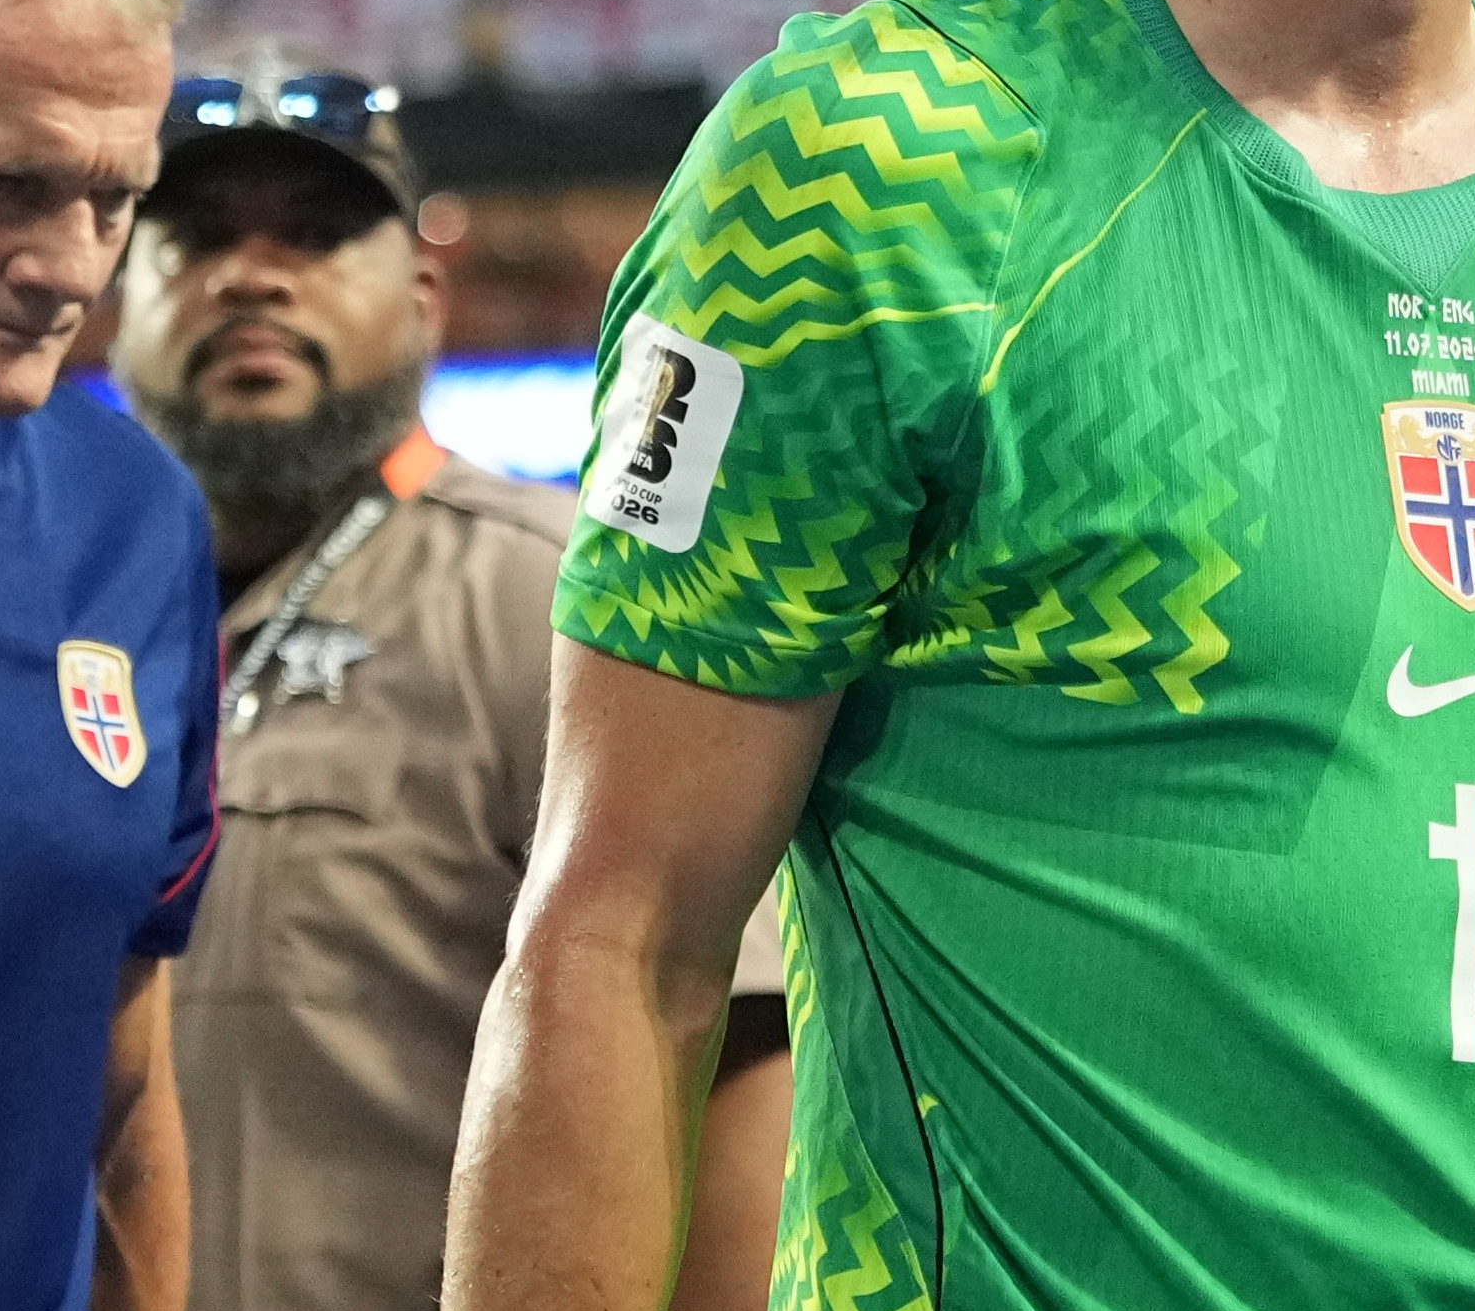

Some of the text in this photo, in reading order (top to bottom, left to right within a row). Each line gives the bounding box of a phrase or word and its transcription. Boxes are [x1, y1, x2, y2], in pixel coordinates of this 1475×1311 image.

[1387, 293, 1423, 320] NOR
[1442, 297, 1475, 325] ENG
[1411, 369, 1470, 397] MIAMI
[1425, 411, 1465, 430] NORGE
[632, 451, 653, 472] IFA
[612, 475, 663, 505] ORLD CUP
[611, 493, 660, 526] 026
